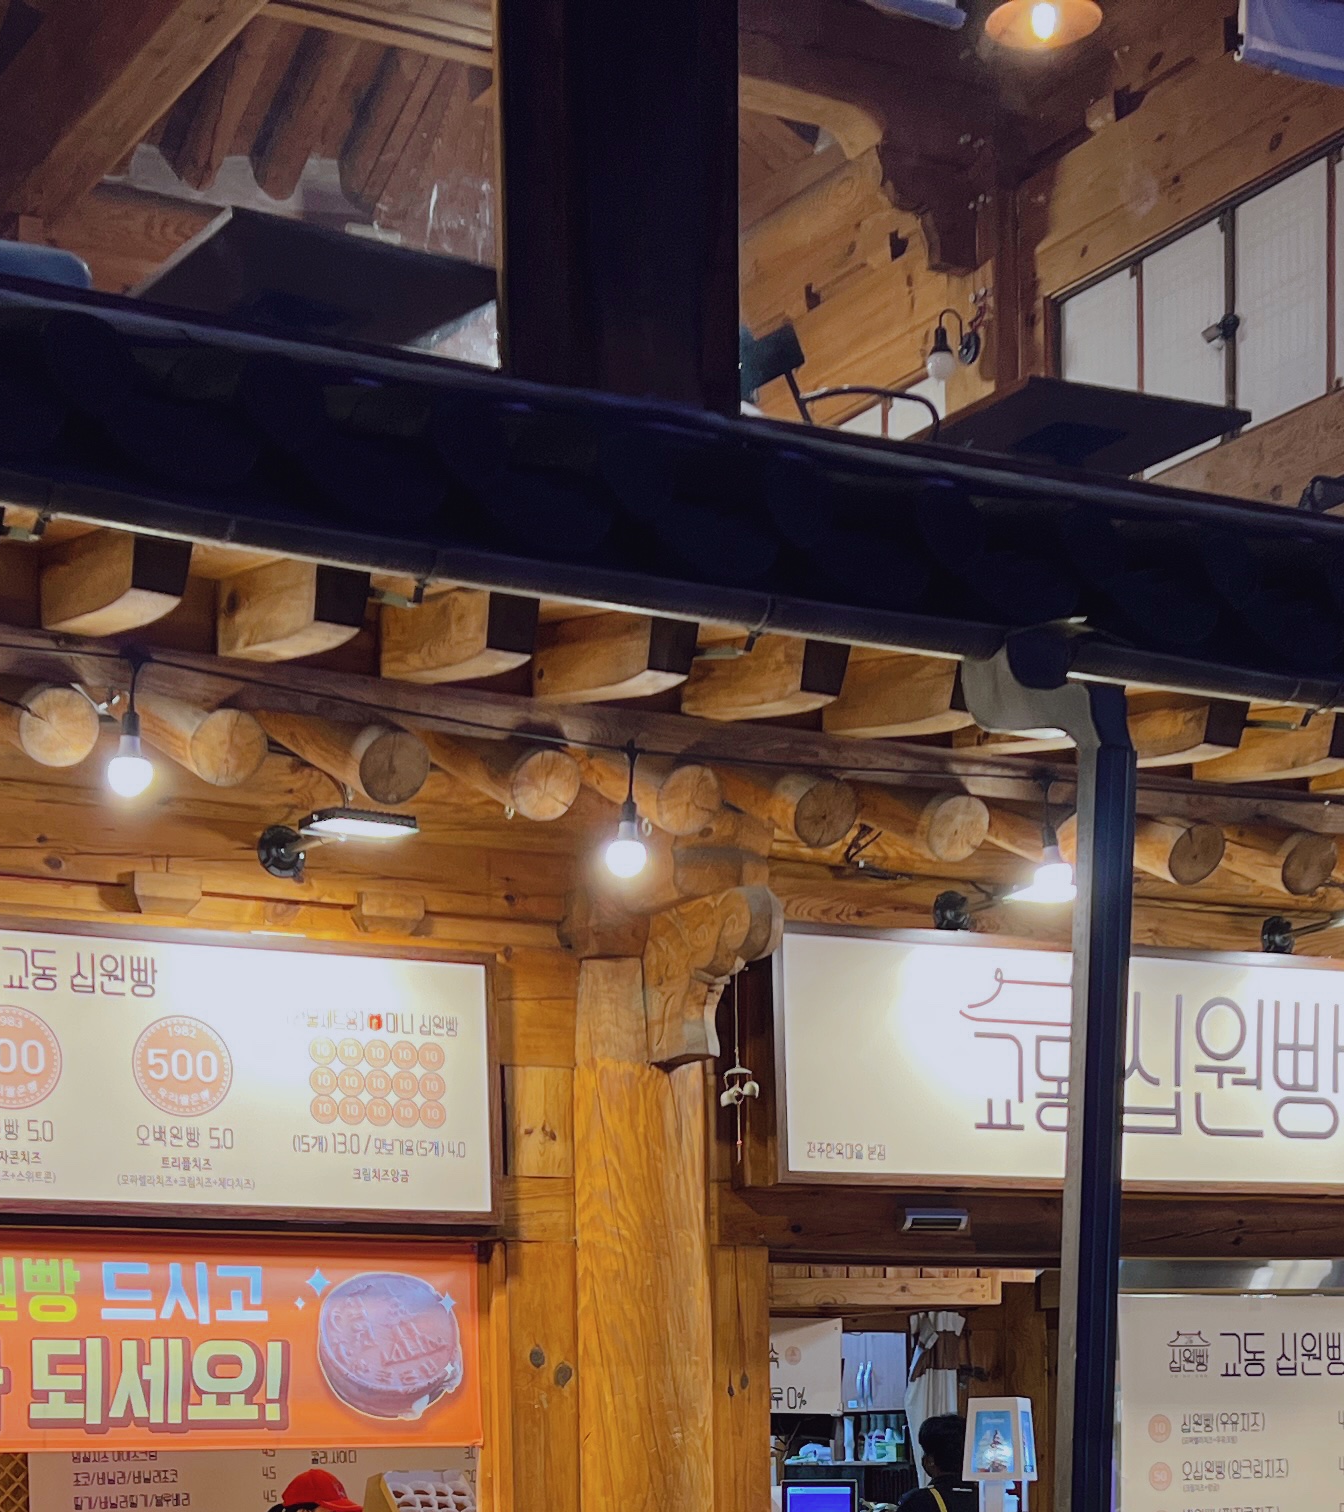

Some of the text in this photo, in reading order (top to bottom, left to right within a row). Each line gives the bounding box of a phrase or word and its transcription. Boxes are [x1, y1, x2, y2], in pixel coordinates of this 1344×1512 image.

[2, 946, 58, 992] 교동
[69, 951, 158, 999] 십원빵
[385, 1012, 414, 1035] 미니
[419, 1013, 459, 1037] 십원빵
[146, 1047, 219, 1083] 500
[27, 1119, 54, 1143] 5.0
[136, 1124, 234, 1150] 오백원빵 5.0
[292, 1134, 328, 1153] (15개)
[160, 1156, 213, 1171] 트리플치즈
[353, 1167, 410, 1183] 크림치즈앙금
[101, 1262, 269, 1324] 드시고
[1219, 1332, 1265, 1377] 교동
[30, 1336, 288, 1431] 되세요!
